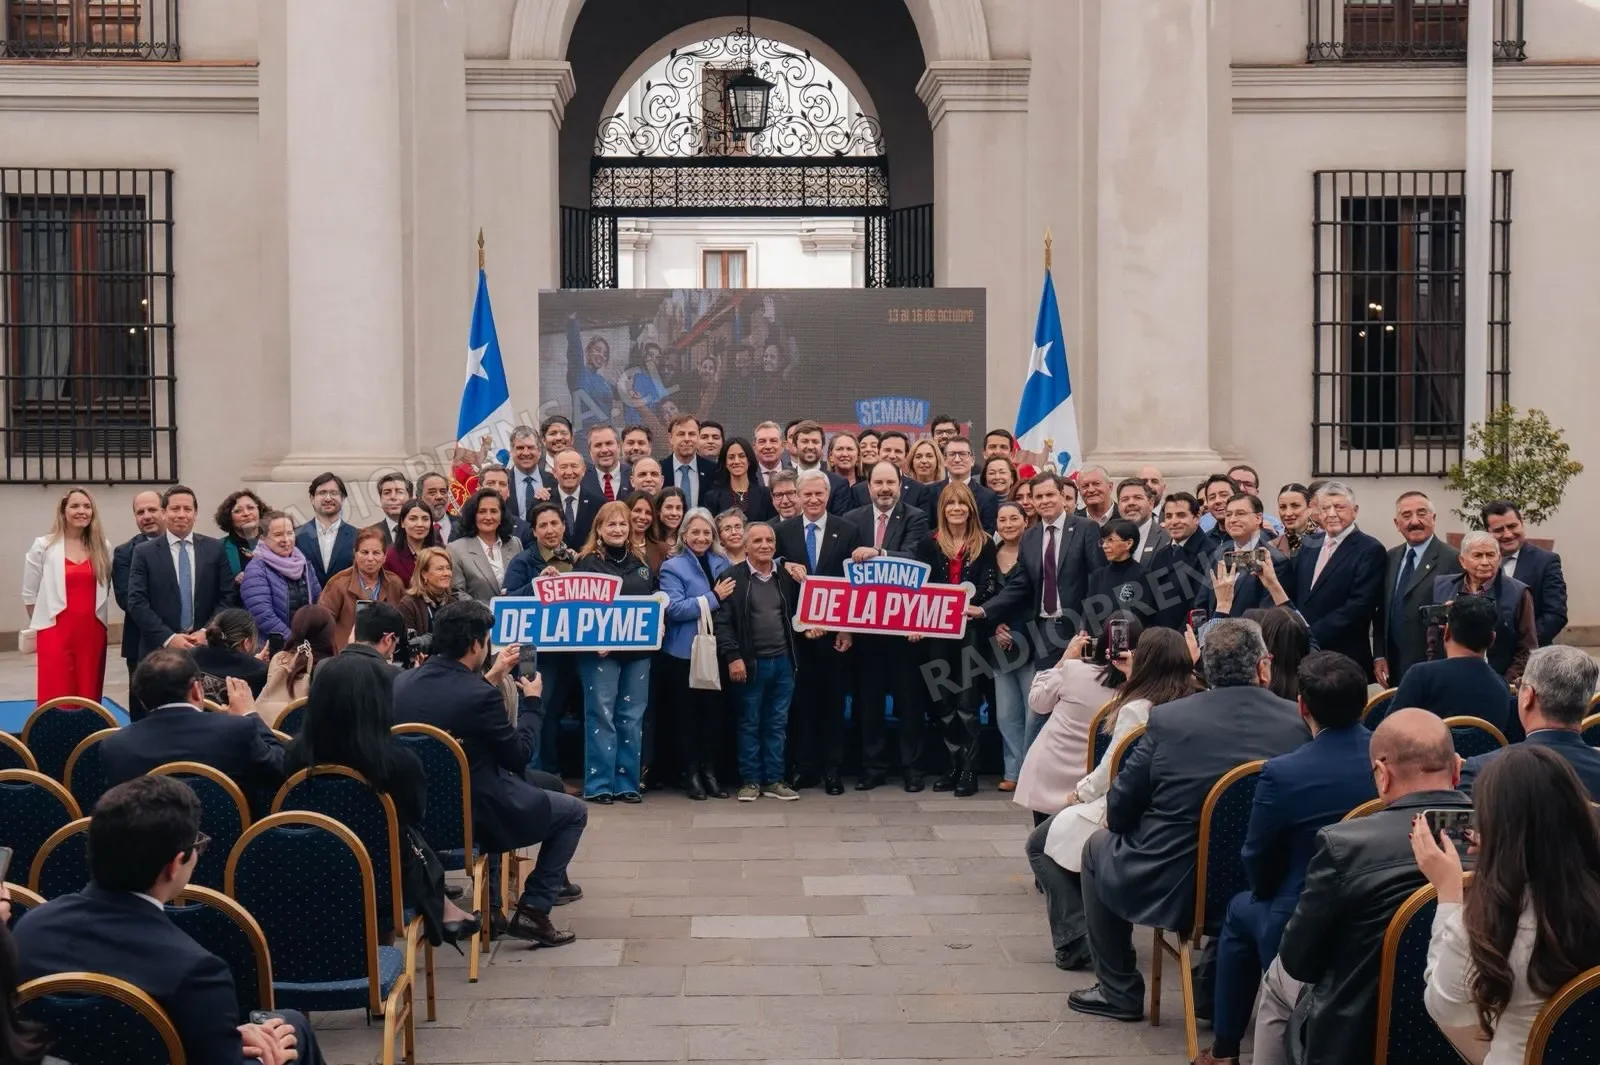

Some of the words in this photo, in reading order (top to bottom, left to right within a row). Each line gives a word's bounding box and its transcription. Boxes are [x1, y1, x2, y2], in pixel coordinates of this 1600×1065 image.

[888, 308, 899, 322] 13
[900, 308, 910, 322] al
[912, 308, 923, 322] 16
[861, 399, 924, 427] SEMANA
[853, 562, 920, 588] SEMANA
[542, 578, 611, 603] SEMANA
[809, 588, 845, 622] DE
[847, 590, 877, 625] LA
[882, 592, 958, 630] PYME
[501, 608, 536, 643] DE
[540, 608, 569, 642] LA
[576, 607, 652, 642] PYME
